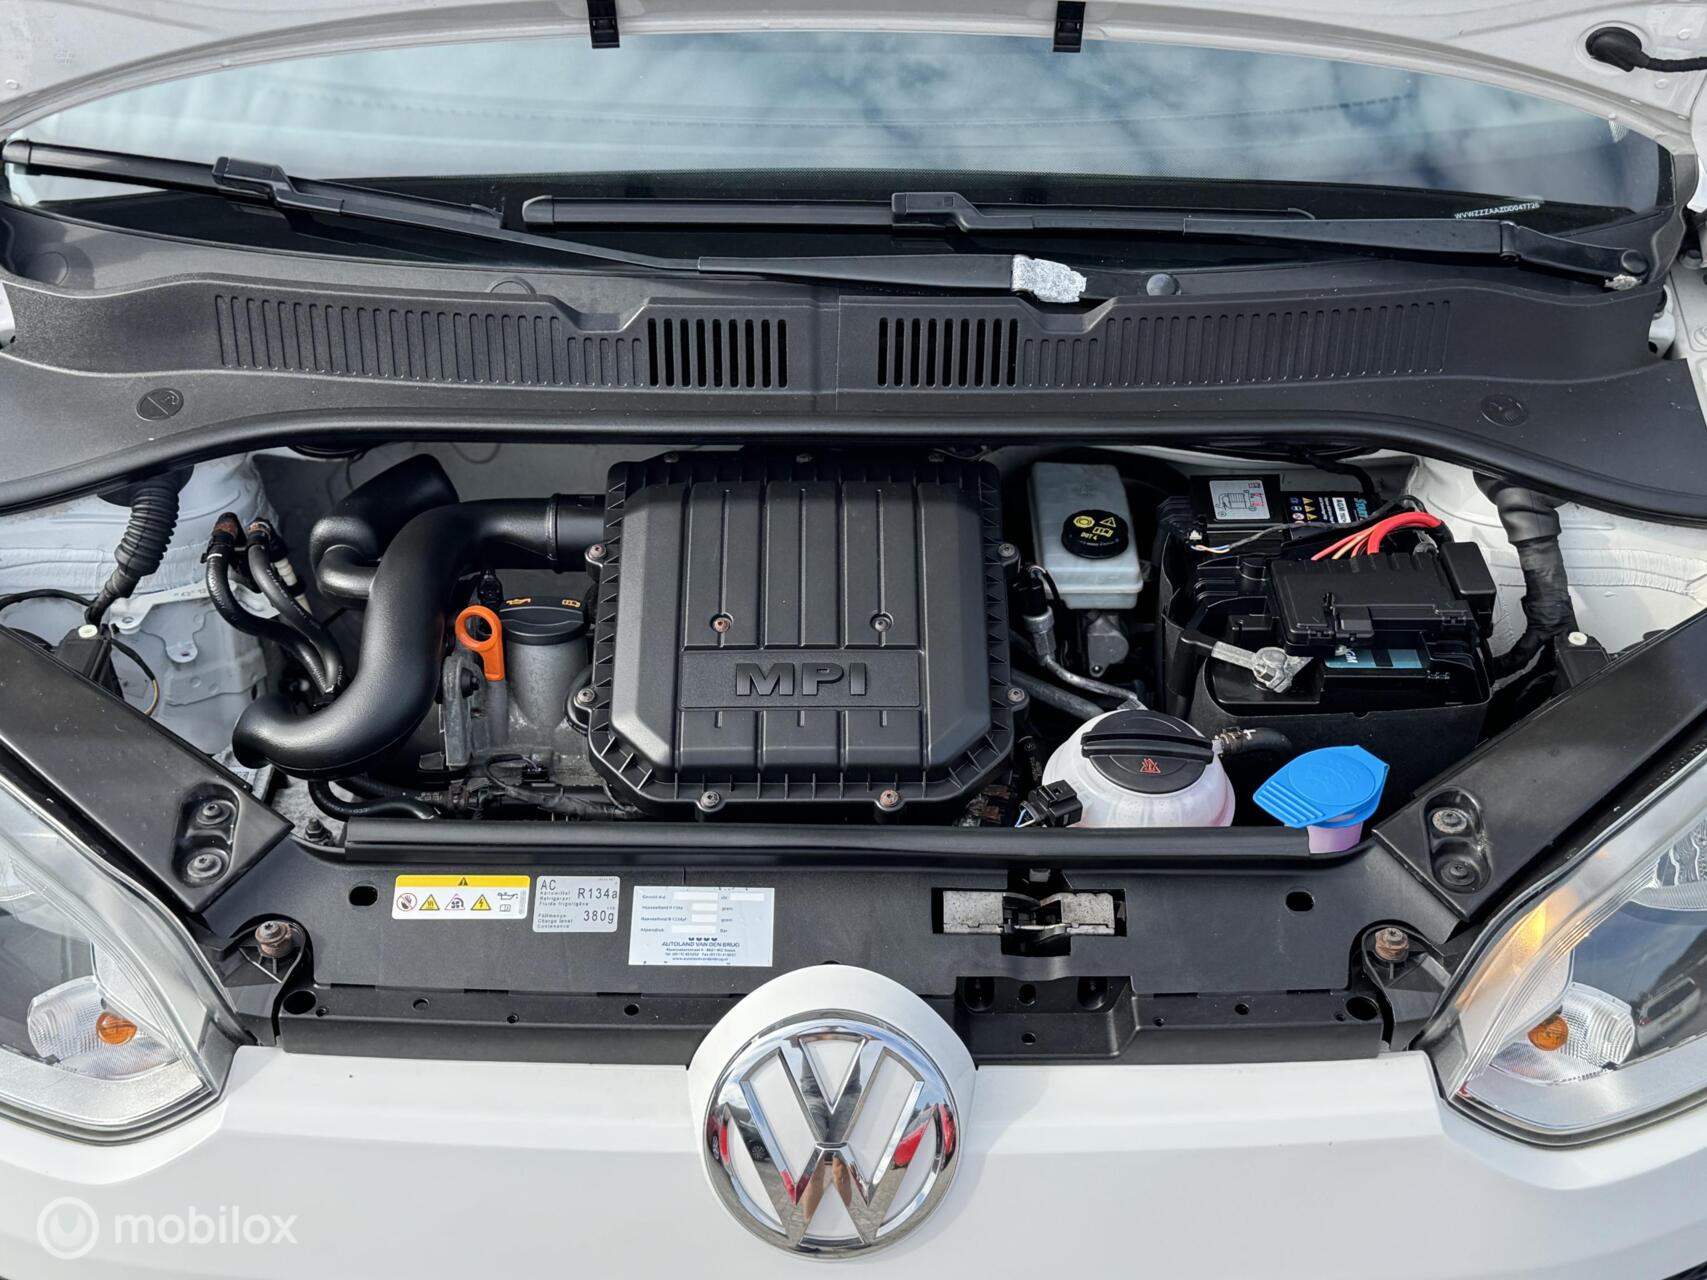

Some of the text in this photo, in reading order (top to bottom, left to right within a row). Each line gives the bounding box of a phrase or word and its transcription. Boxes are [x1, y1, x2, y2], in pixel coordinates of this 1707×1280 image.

[736, 662, 867, 696] MPI
[540, 880, 556, 891] AC
[577, 887, 618, 899] R134a
[583, 910, 614, 924] 380g
